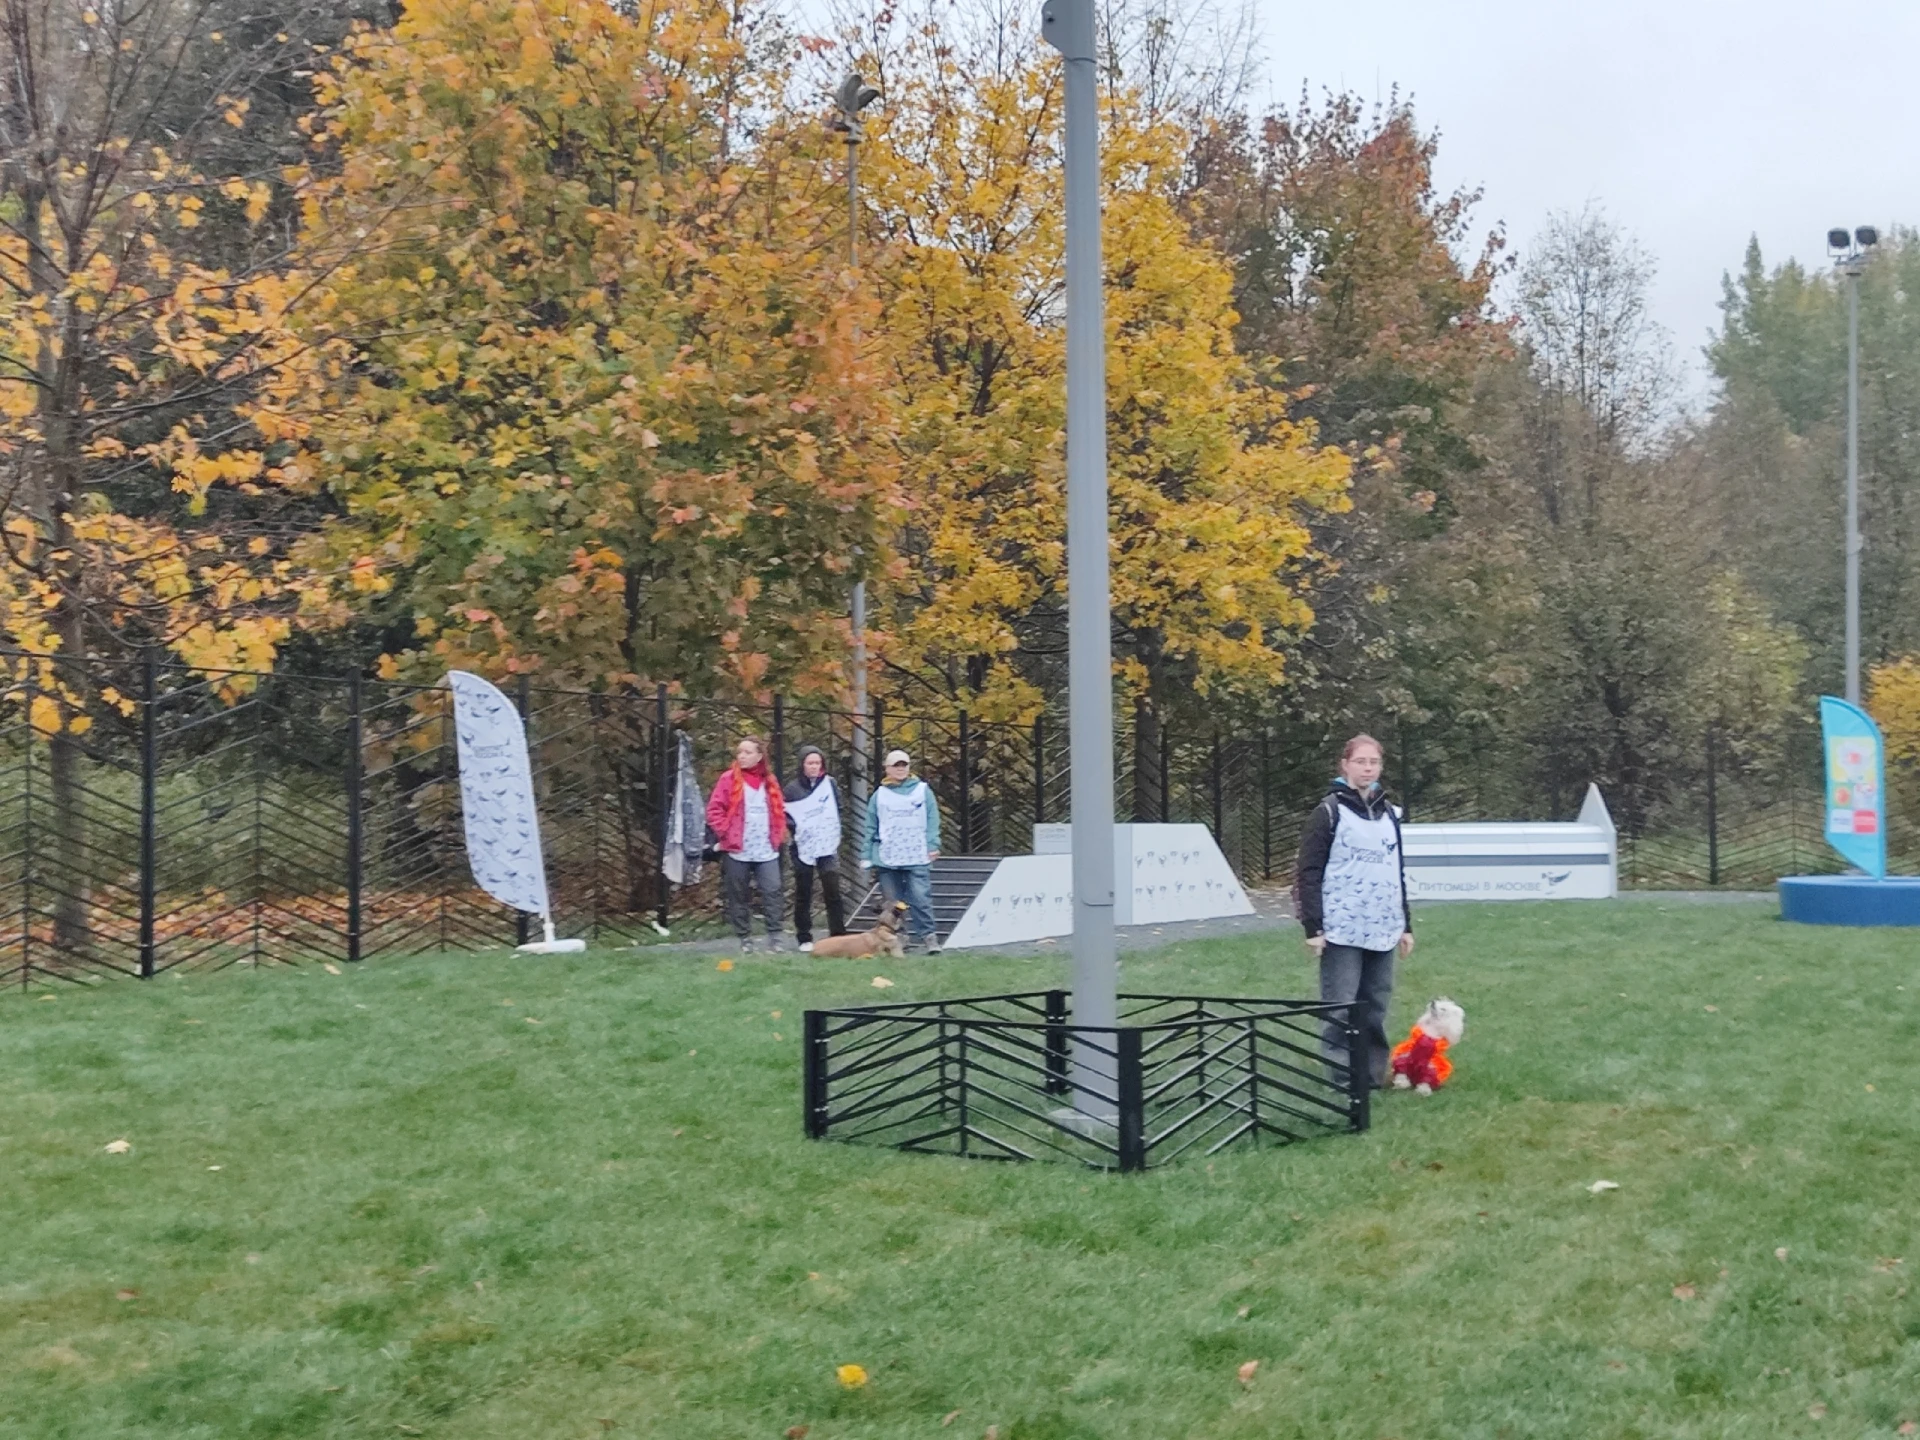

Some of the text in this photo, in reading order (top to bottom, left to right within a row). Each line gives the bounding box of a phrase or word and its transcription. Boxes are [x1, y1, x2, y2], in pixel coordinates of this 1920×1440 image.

[1418, 882, 1542, 892] ПИТОМЦЫ В МОСКВЕ
